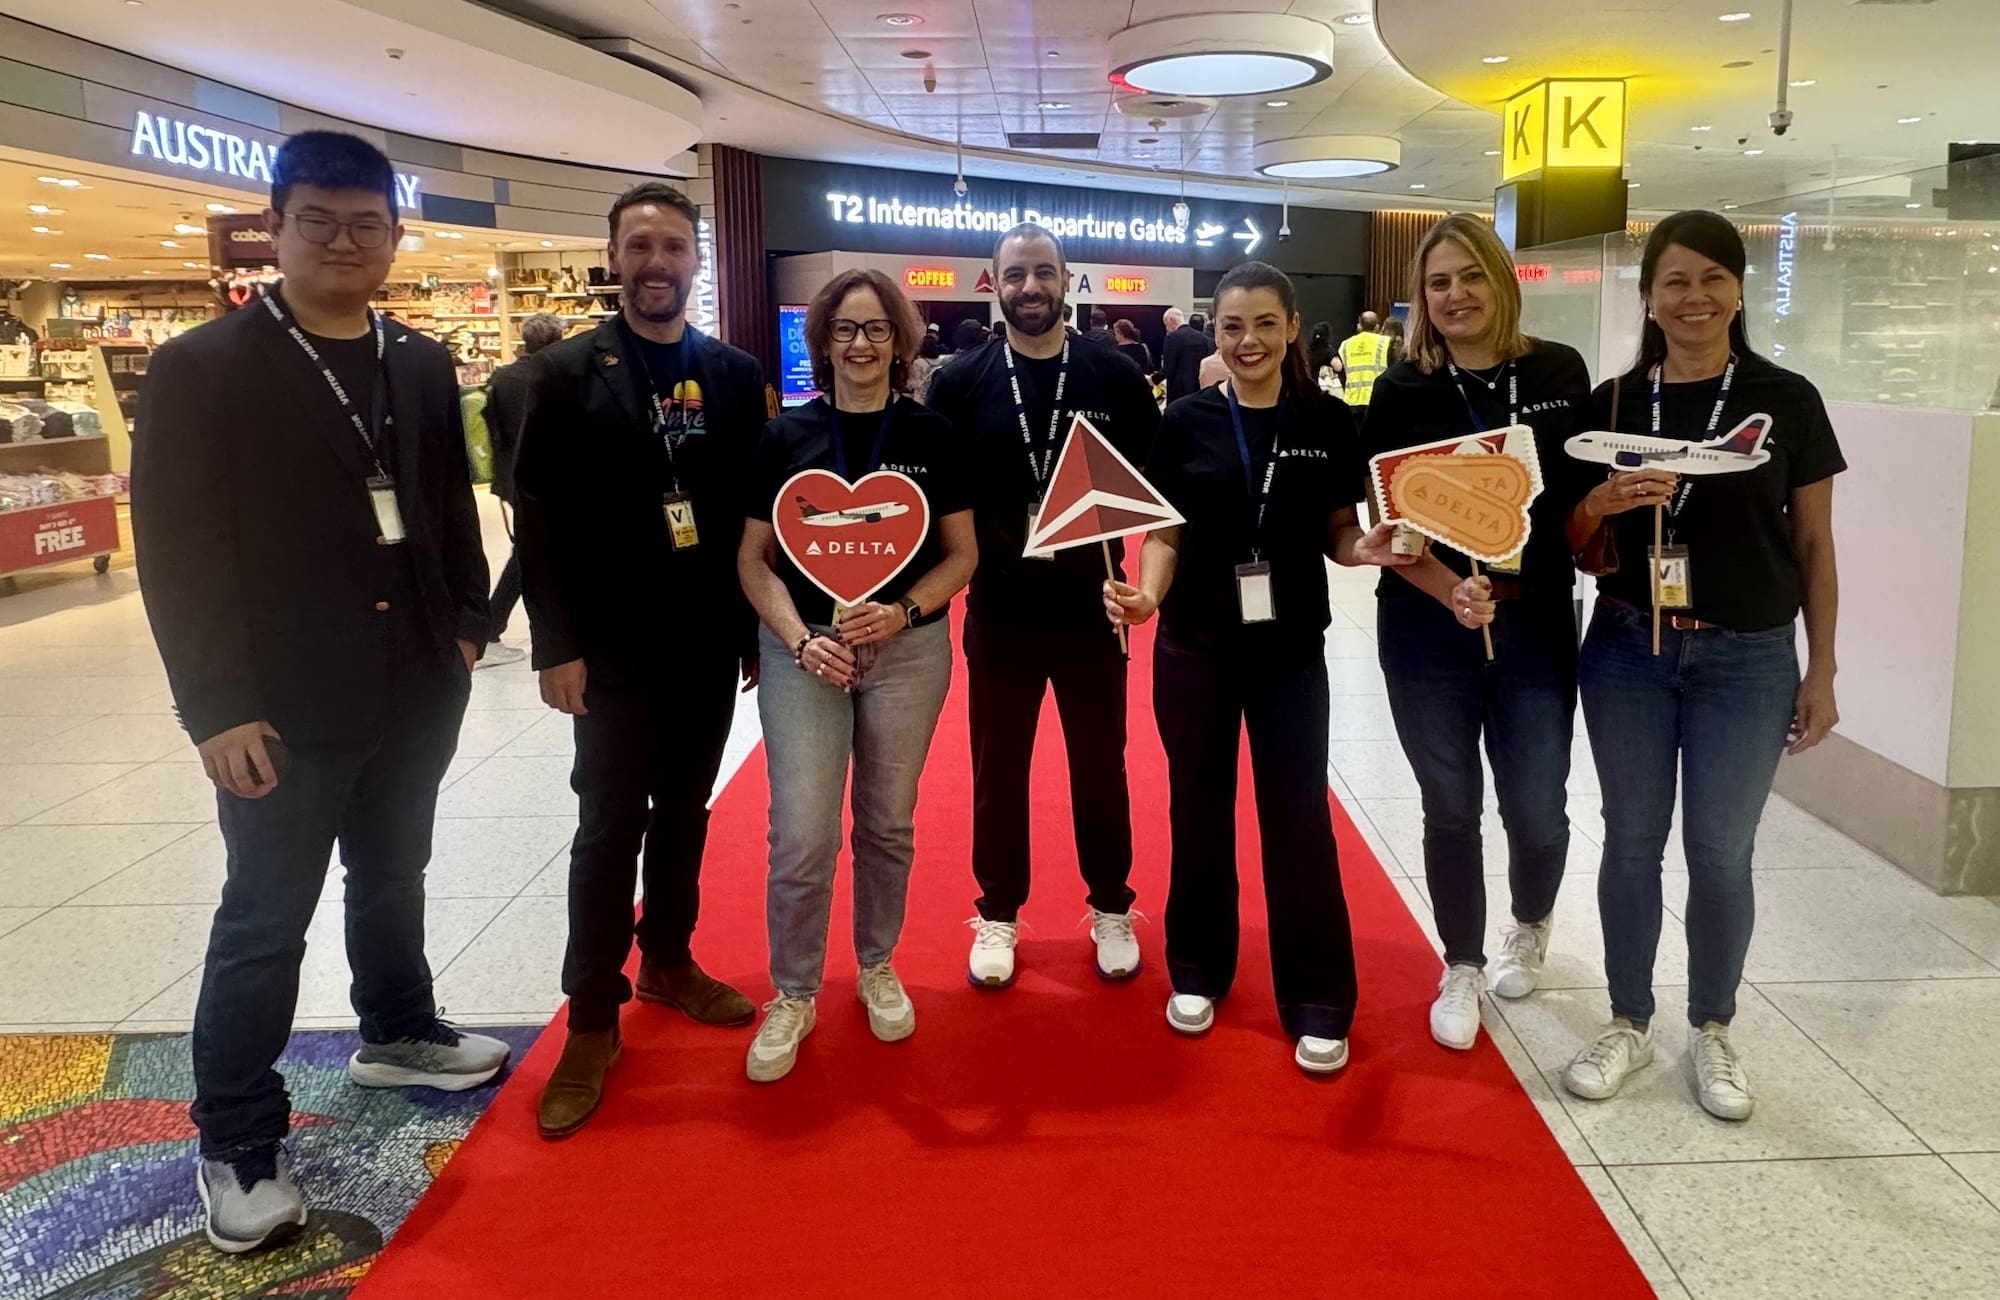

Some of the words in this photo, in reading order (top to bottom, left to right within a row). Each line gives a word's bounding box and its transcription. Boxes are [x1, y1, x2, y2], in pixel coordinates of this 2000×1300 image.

[1513, 104, 1531, 160] K
[1562, 96, 1608, 148] K
[826, 193, 865, 222] T2
[868, 197, 1016, 233] International
[1130, 218, 1186, 243] Gates
[908, 270, 954, 285] COFFEE
[1107, 277, 1146, 292] DONUTS
[288, 326, 319, 361] VISITOR
[322, 368, 349, 406] VISITOR
[1010, 375, 1022, 405] VISITOR
[1055, 372, 1066, 400] VISITOR
[1509, 376, 1517, 404] VISITOR
[1721, 362, 1735, 391] VISITOR
[1532, 400, 1570, 412] DELTA
[1651, 401, 1660, 432] VISITOR
[1707, 400, 1725, 431] VISITOR
[1019, 412, 1031, 443] VISITOR
[1048, 409, 1059, 440] VISITOR
[890, 463, 928, 473] DELTA
[1291, 449, 1328, 459] DELTA
[1262, 462, 1275, 493] VISITOR
[1435, 494, 1500, 535] DELTA
[34, 525, 86, 555] FREE
[828, 541, 897, 555] DELTA
